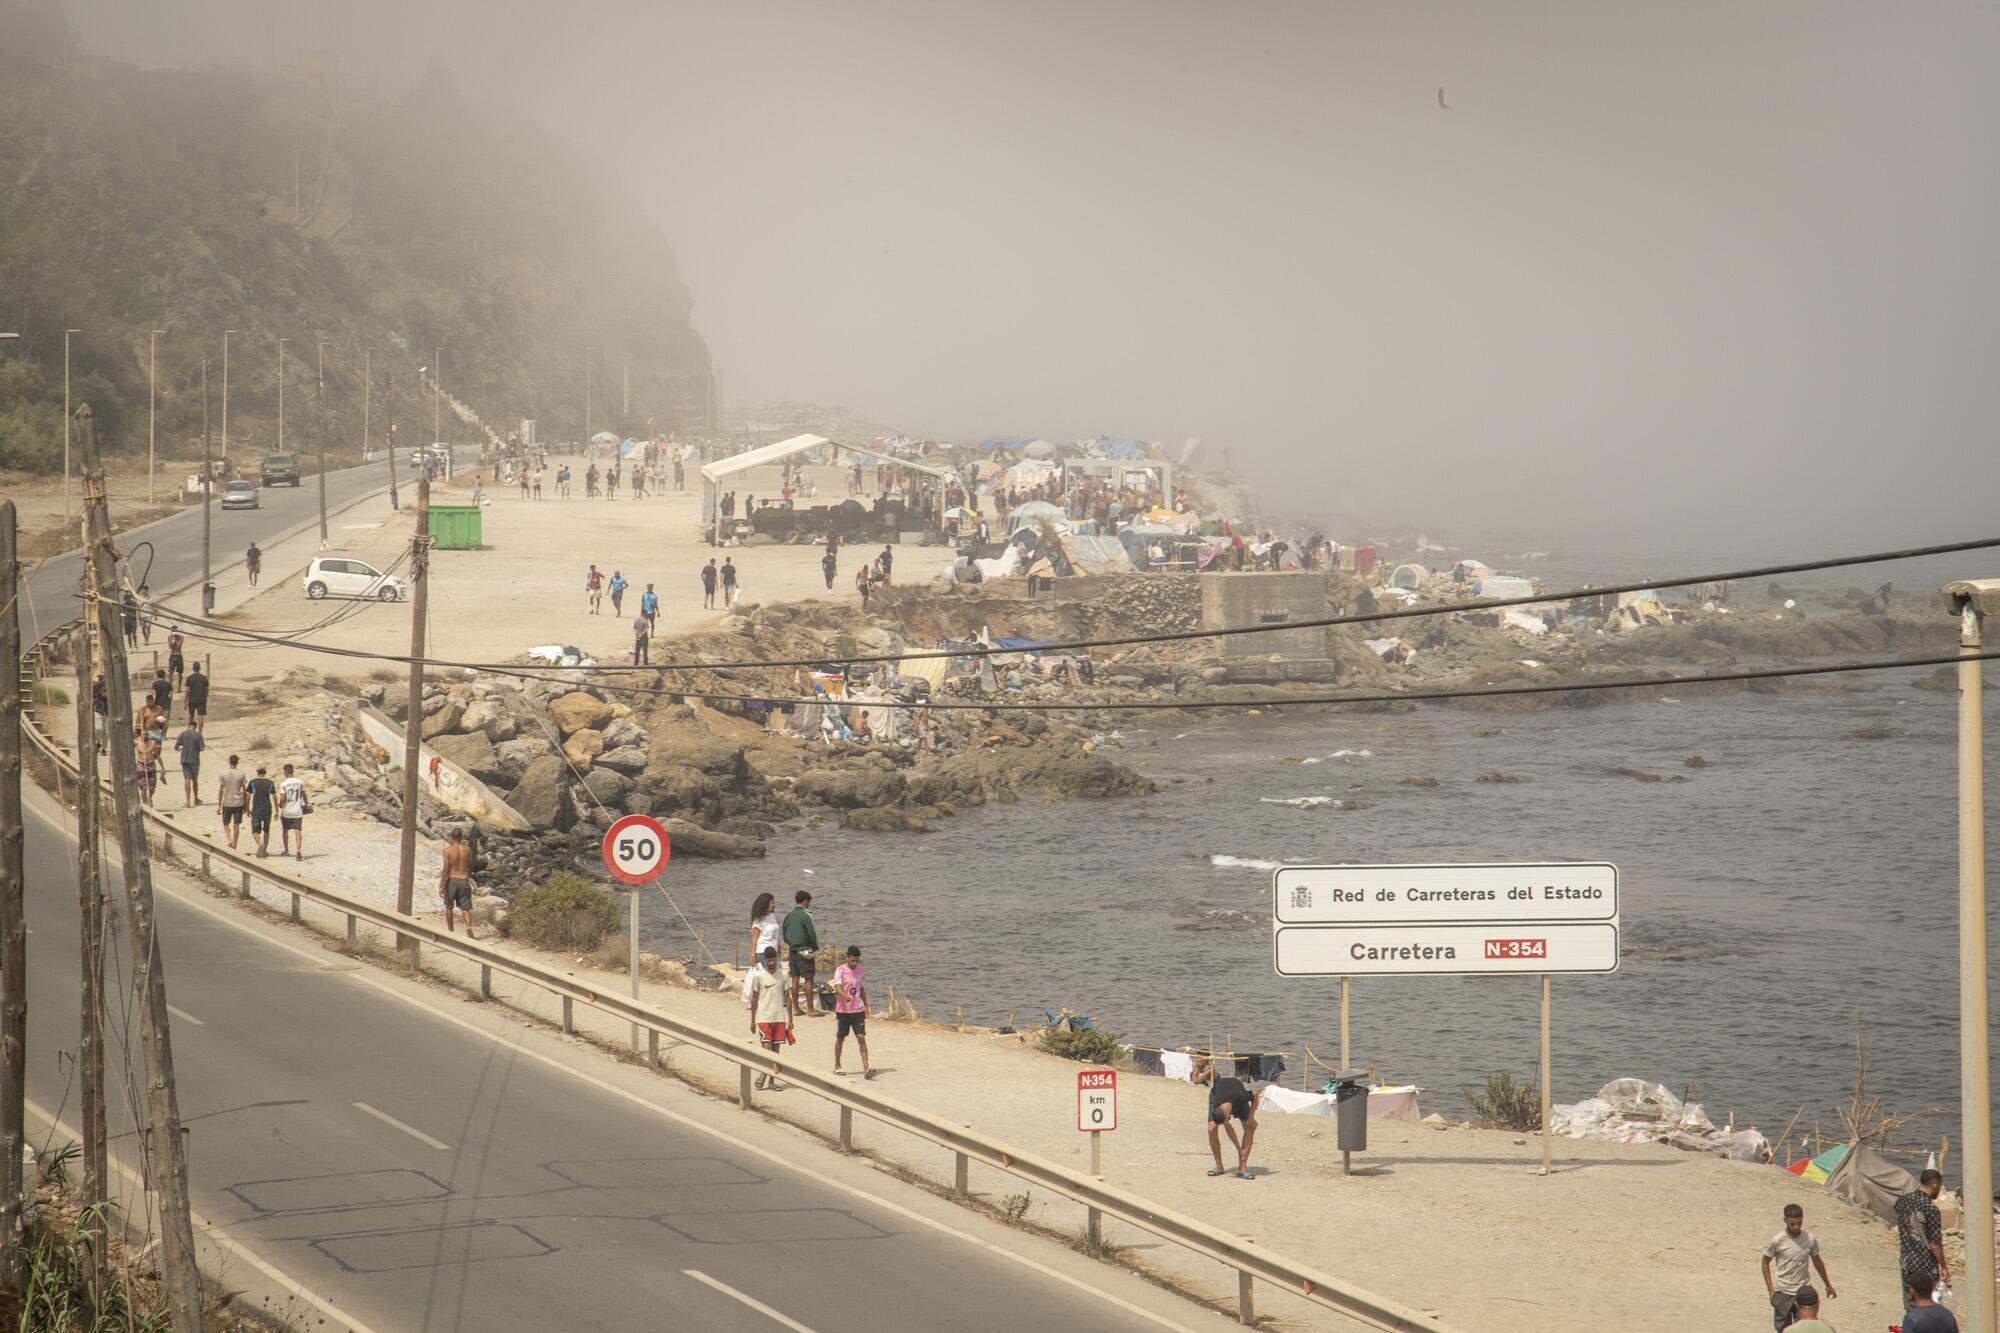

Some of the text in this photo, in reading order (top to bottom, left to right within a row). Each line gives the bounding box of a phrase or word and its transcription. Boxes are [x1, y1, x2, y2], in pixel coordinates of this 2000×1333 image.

[287, 788, 299, 803] 21
[618, 838, 656, 862] 50
[1333, 885, 1603, 902] Red de Carreteras del Estado
[1350, 941, 1544, 960] Carretera N-354
[1081, 1074, 1113, 1087] N-354
[1089, 1095, 1105, 1105] km
[1091, 1108, 1103, 1124] 0
